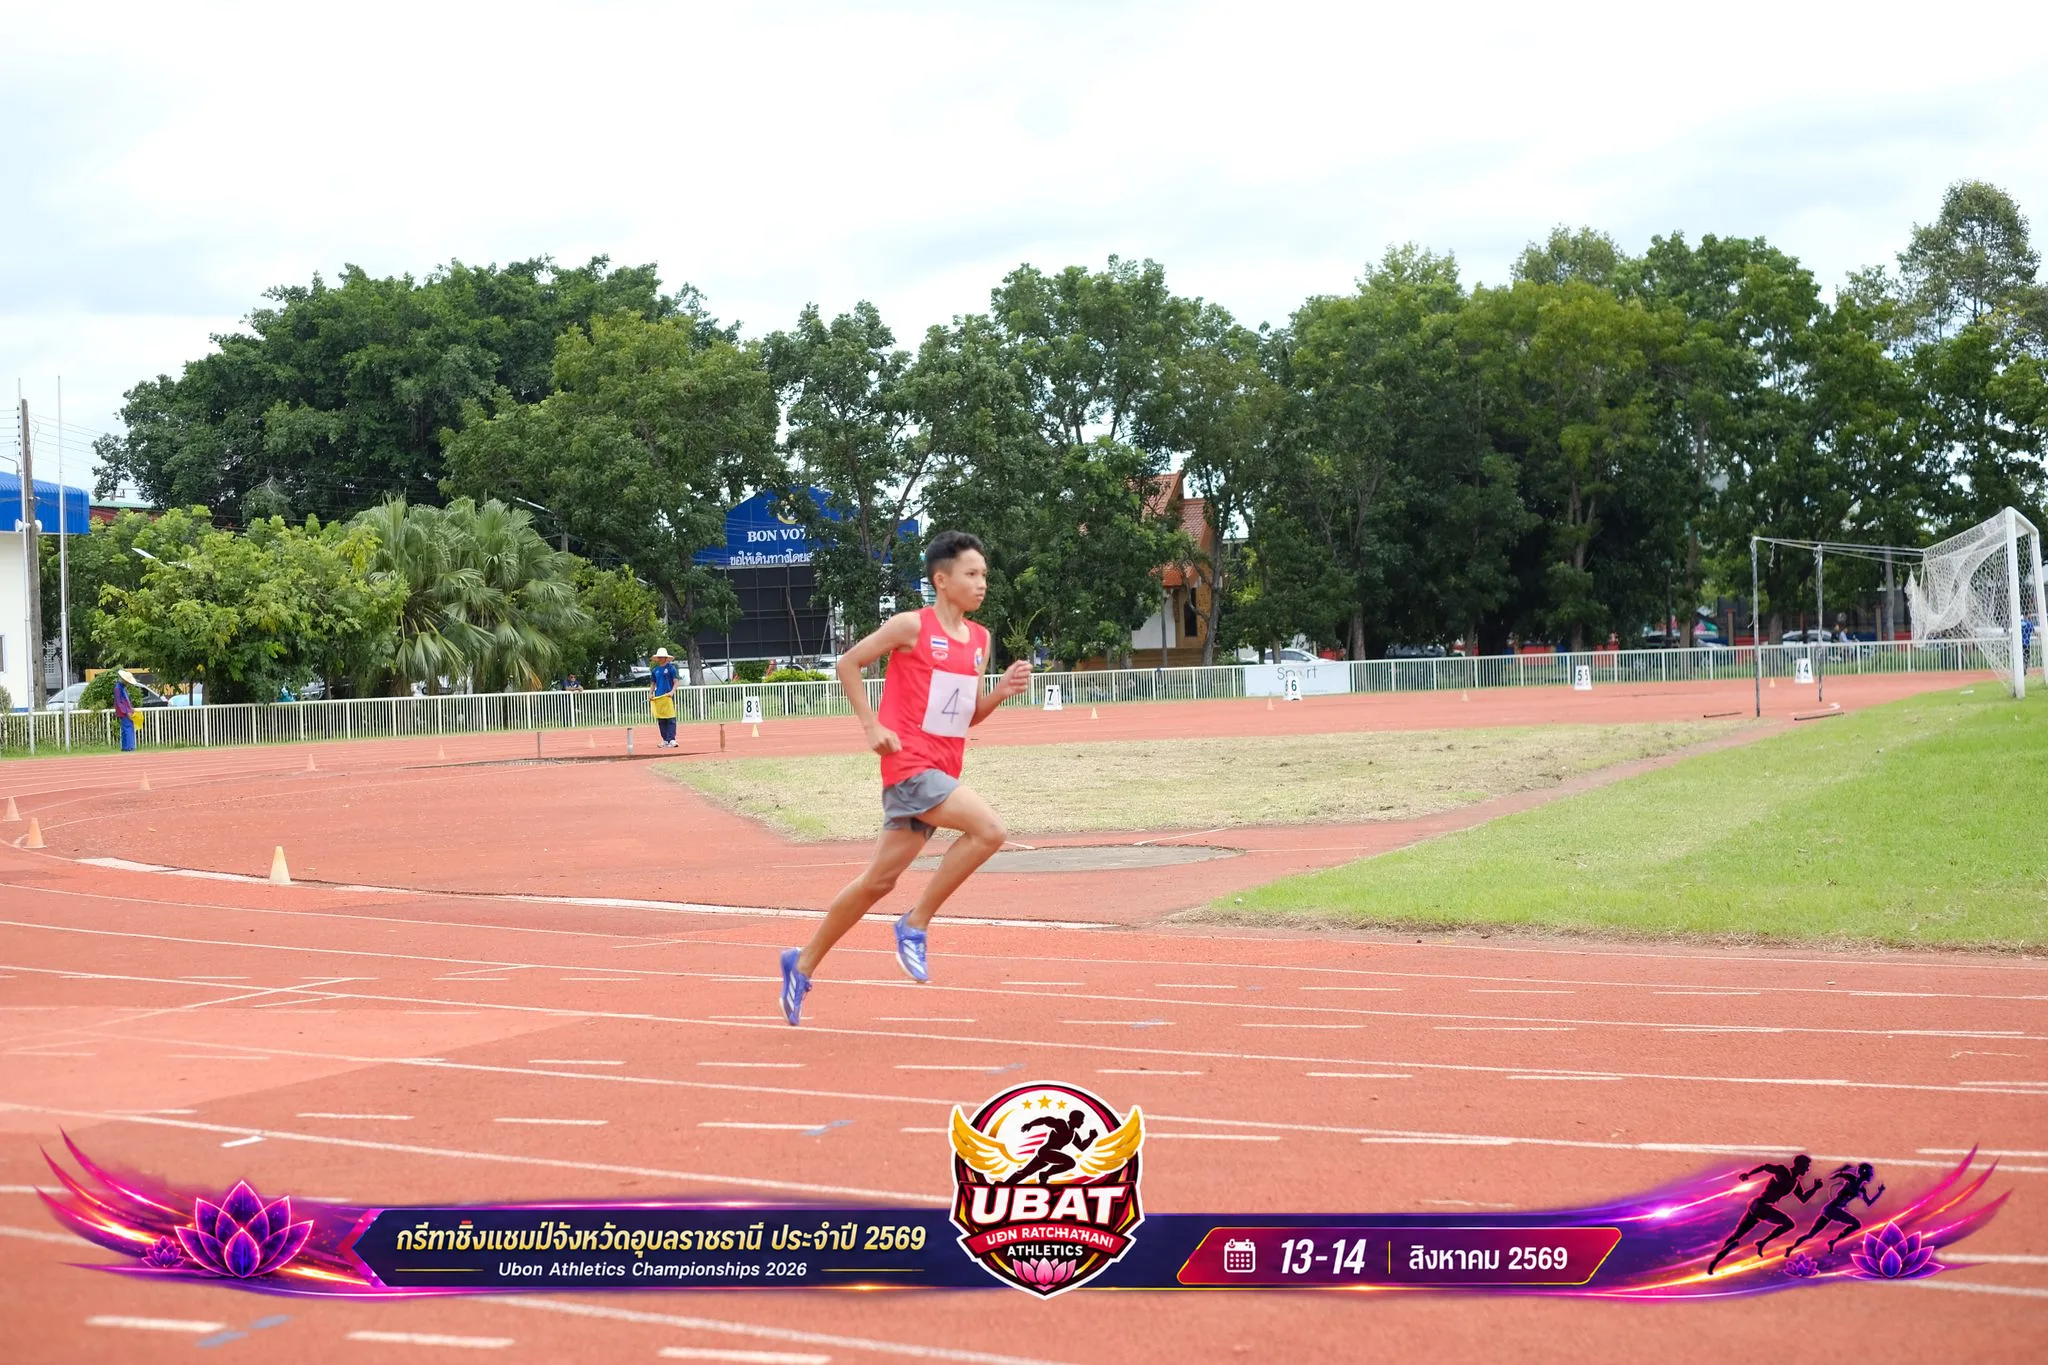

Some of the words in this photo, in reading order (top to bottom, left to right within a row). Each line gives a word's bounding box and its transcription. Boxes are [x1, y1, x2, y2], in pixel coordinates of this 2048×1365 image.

[747, 529, 777, 543] BON
[1577, 669, 1583, 681] 5
[1291, 679, 1297, 692] 6
[1047, 688, 1054, 702] 7
[746, 700, 752, 713] 8
[941, 687, 960, 724] 4
